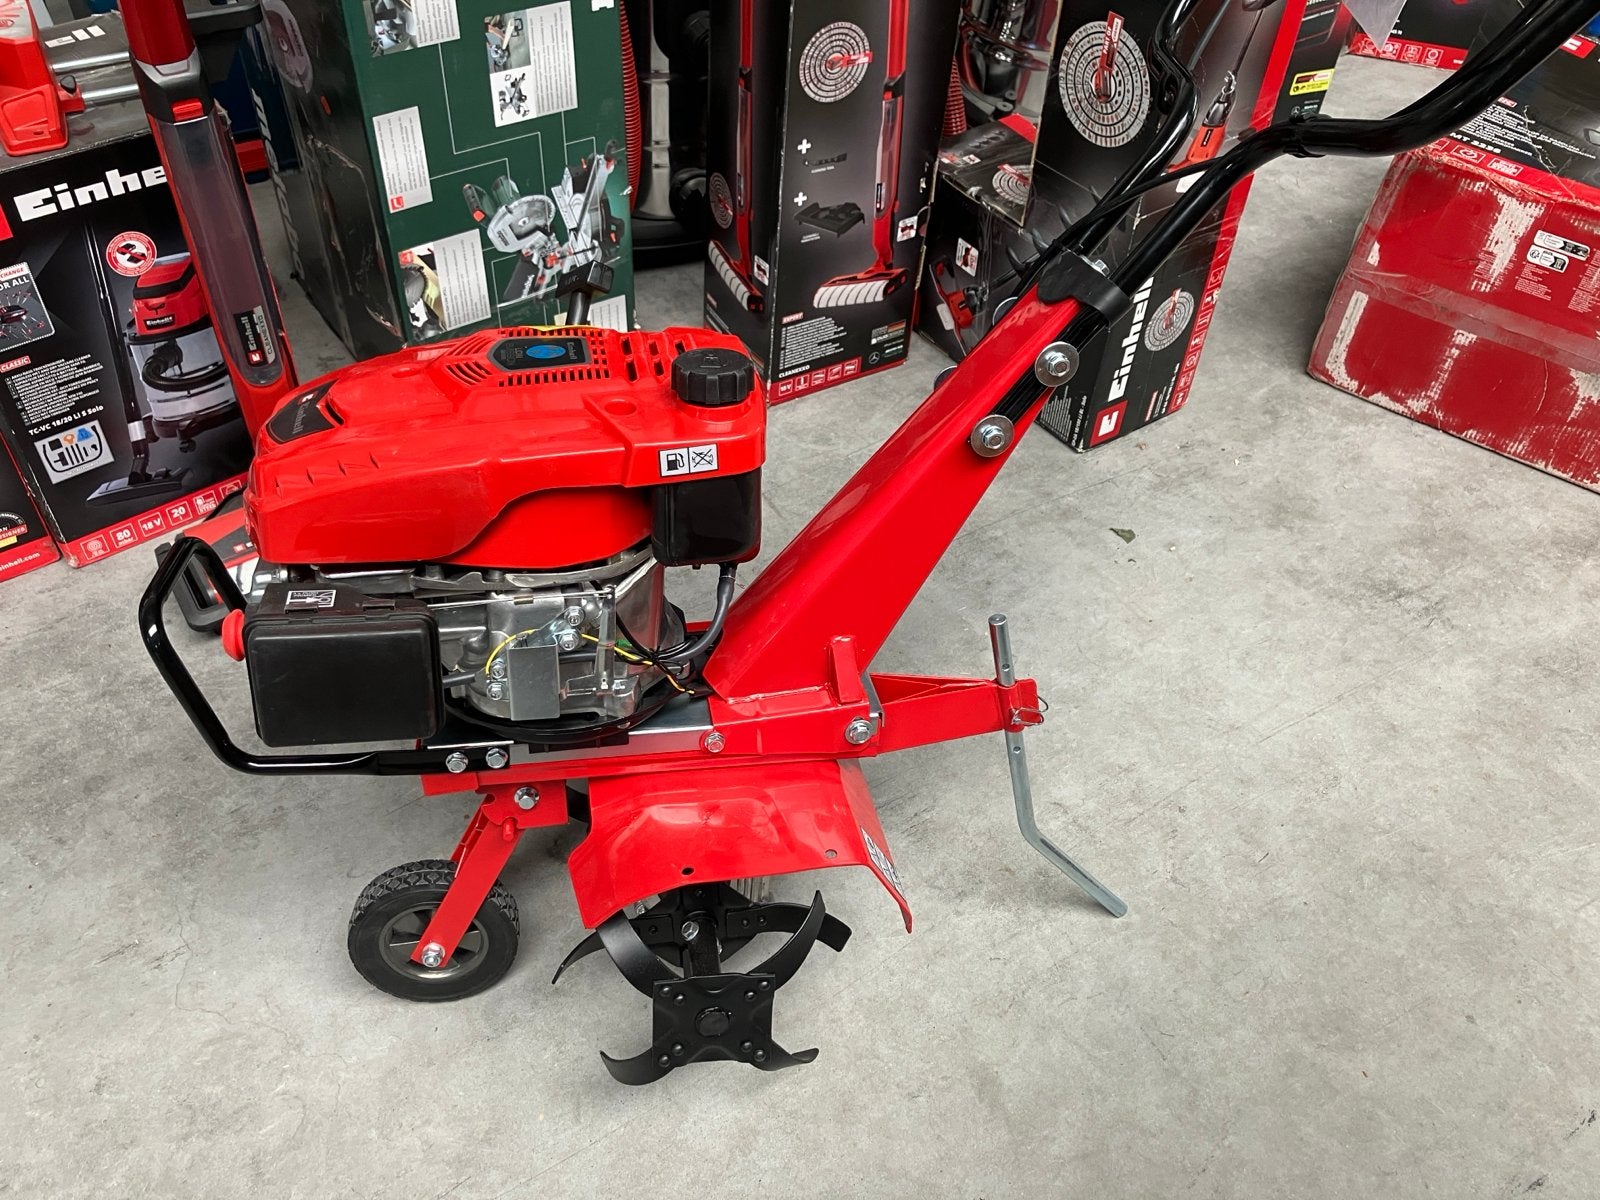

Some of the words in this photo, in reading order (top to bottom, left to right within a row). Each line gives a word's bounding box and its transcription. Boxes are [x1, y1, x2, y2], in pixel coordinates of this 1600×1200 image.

[1450, 132, 1469, 143] MT
[13, 165, 168, 222] Einhe
[12, 276, 30, 288] ALL
[241, 316, 257, 351] Einhell
[1108, 276, 1154, 402] Einhell
[1, 358, 29, 371] CLASSIC
[29, 423, 52, 436] TC-VC
[86, 403, 104, 414] Solo
[172, 506, 186, 518] 20
[143, 521, 154, 532] 18
[154, 518, 162, 528] V
[116, 529, 130, 541] 80
